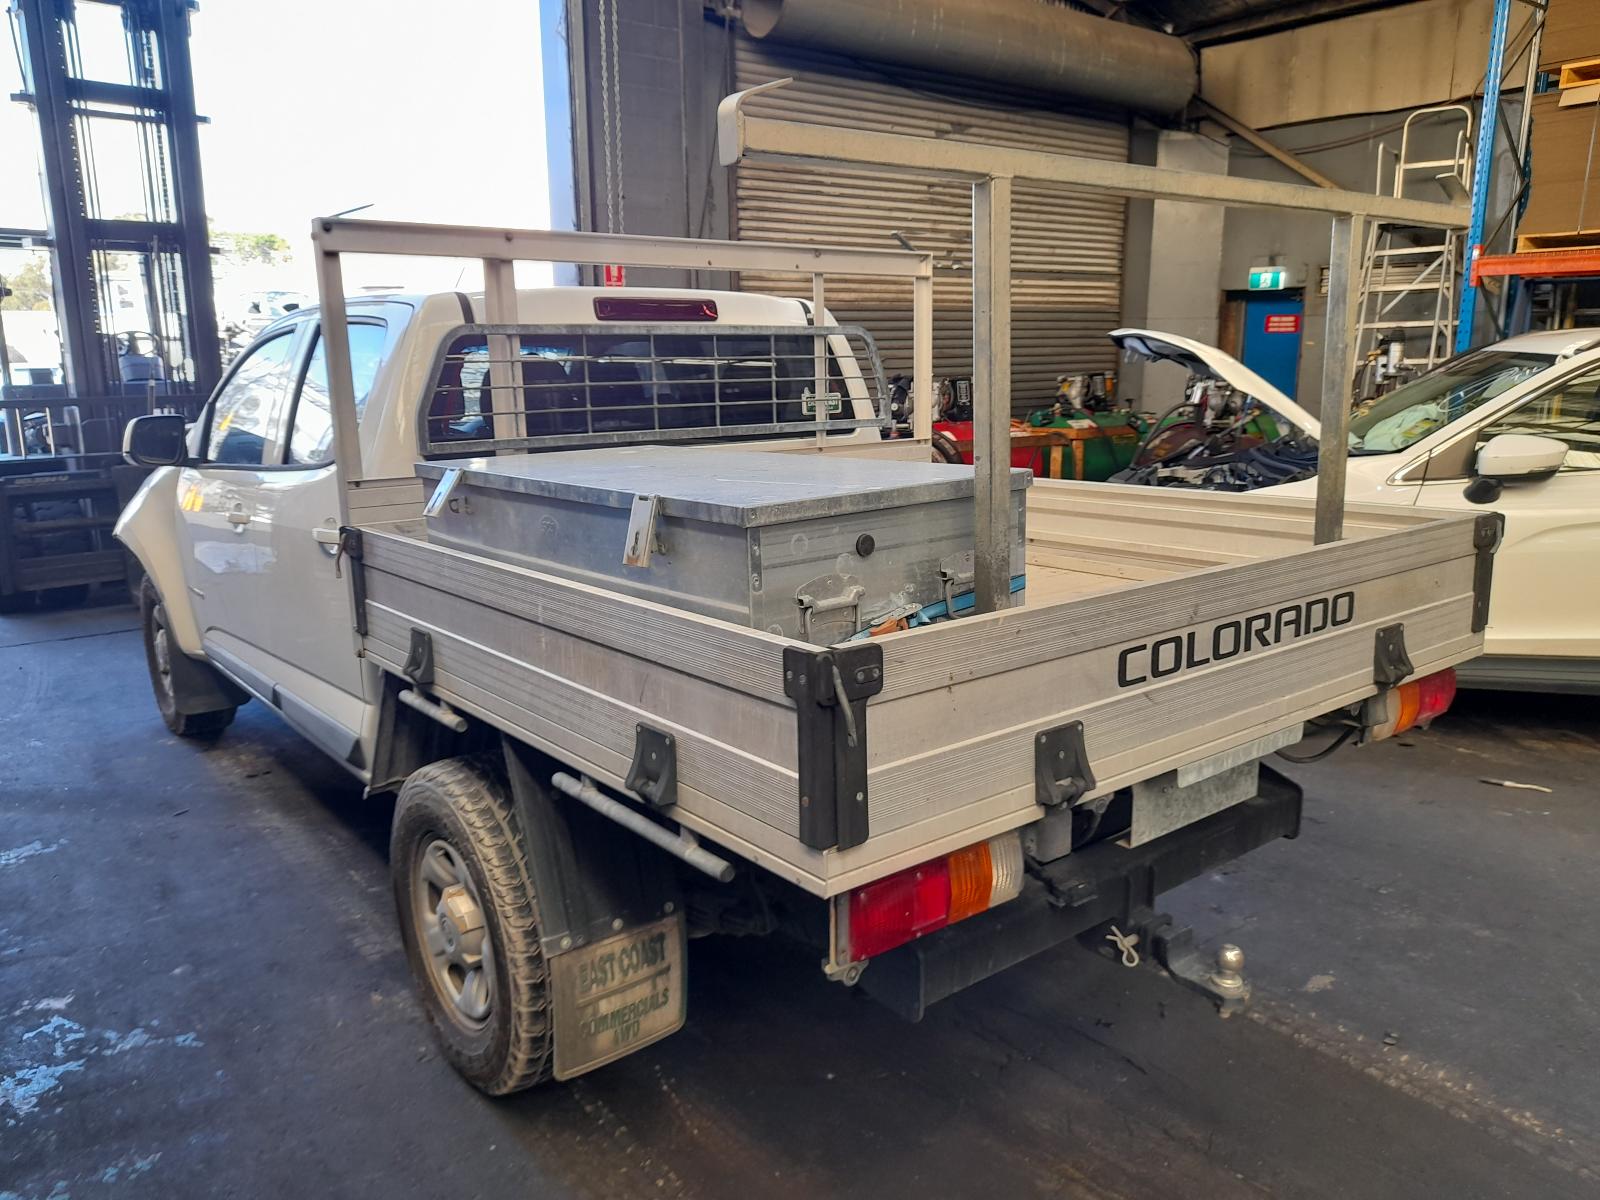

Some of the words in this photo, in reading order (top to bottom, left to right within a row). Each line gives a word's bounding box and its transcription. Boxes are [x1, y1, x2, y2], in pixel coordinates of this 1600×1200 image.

[1117, 591, 1355, 688] COLORADO
[577, 952, 616, 994] EAST
[620, 932, 666, 977] COAST
